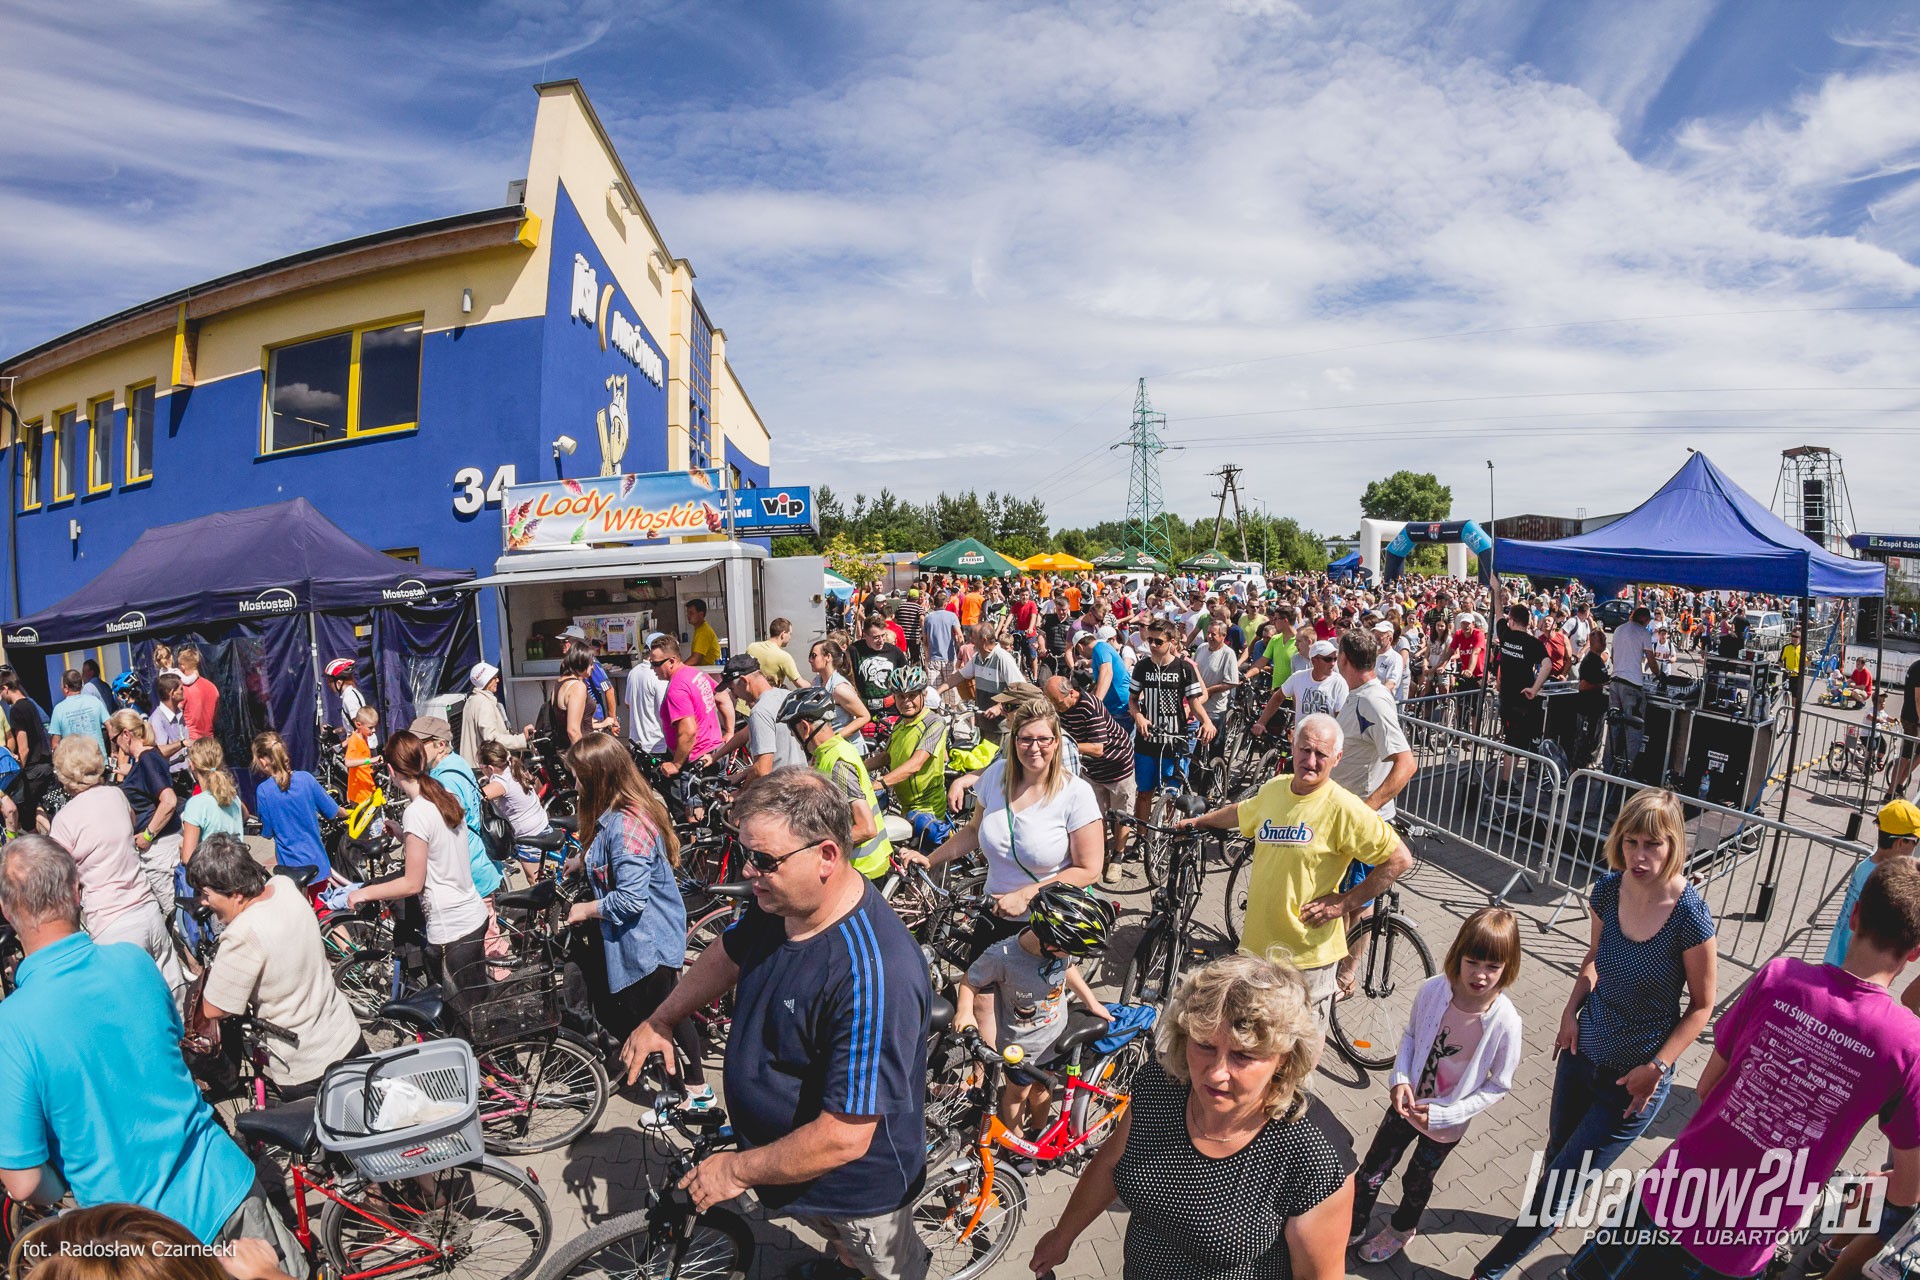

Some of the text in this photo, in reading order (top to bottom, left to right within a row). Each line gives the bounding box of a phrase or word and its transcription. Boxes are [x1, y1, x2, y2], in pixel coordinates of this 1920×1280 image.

[454, 464, 516, 514] 34
[536, 490, 704, 532] Lody Włoskie
[382, 588, 425, 599] Mostostal
[239, 597, 292, 611] Mostostal
[106, 617, 144, 633] Mostostal
[7, 634, 37, 644] Mostostal
[1260, 819, 1306, 840] Snatch
[1773, 1000, 1875, 1058] XXI ŚWIĘTO ROWERU
